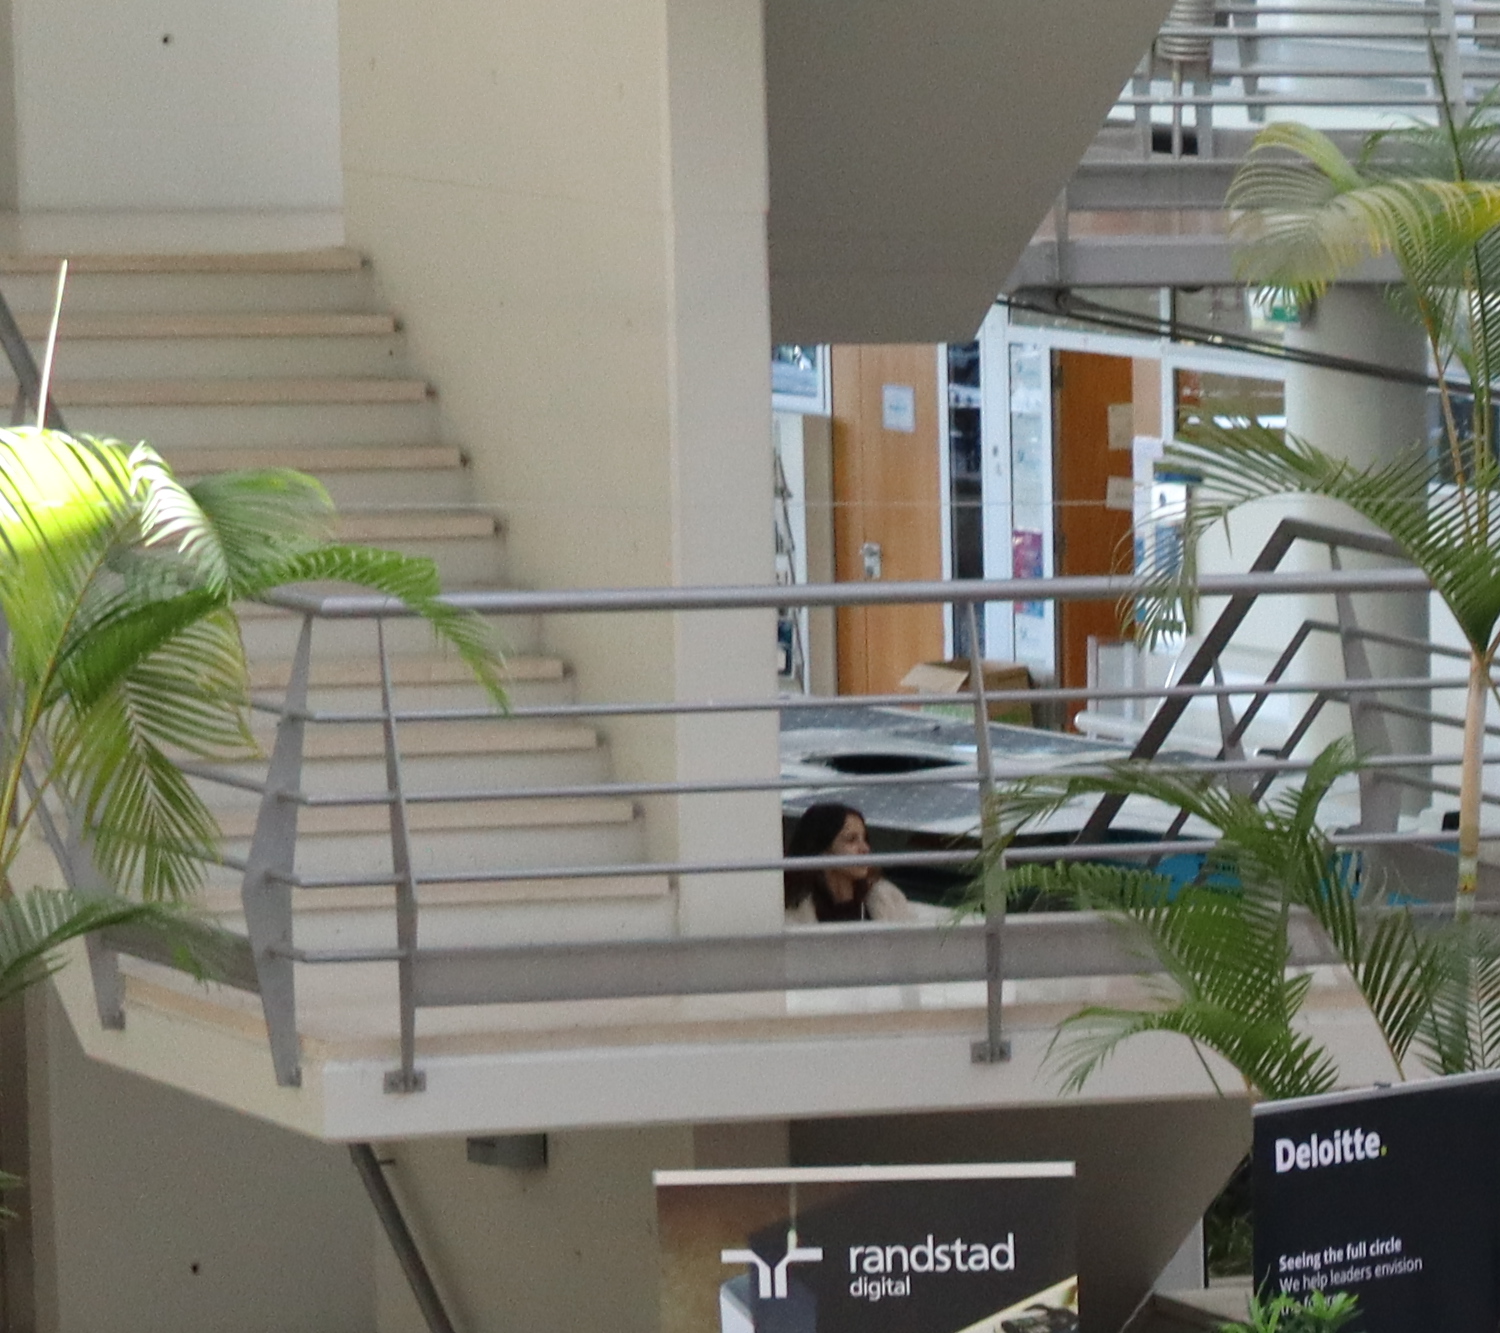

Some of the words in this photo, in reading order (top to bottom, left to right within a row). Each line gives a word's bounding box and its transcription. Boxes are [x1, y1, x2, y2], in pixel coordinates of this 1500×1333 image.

[1275, 1127, 1387, 1173] Deloitte.
[849, 1231, 1016, 1274] randstad
[1279, 1251, 1322, 1273] Seeing
[1324, 1246, 1344, 1264] the
[1347, 1241, 1367, 1260] full
[1370, 1236, 1402, 1257] circle
[849, 1276, 912, 1302] digital
[1280, 1277, 1300, 1294] We
[1303, 1271, 1328, 1291] help
[1331, 1264, 1373, 1286] leaders
[1375, 1256, 1423, 1278] envision
